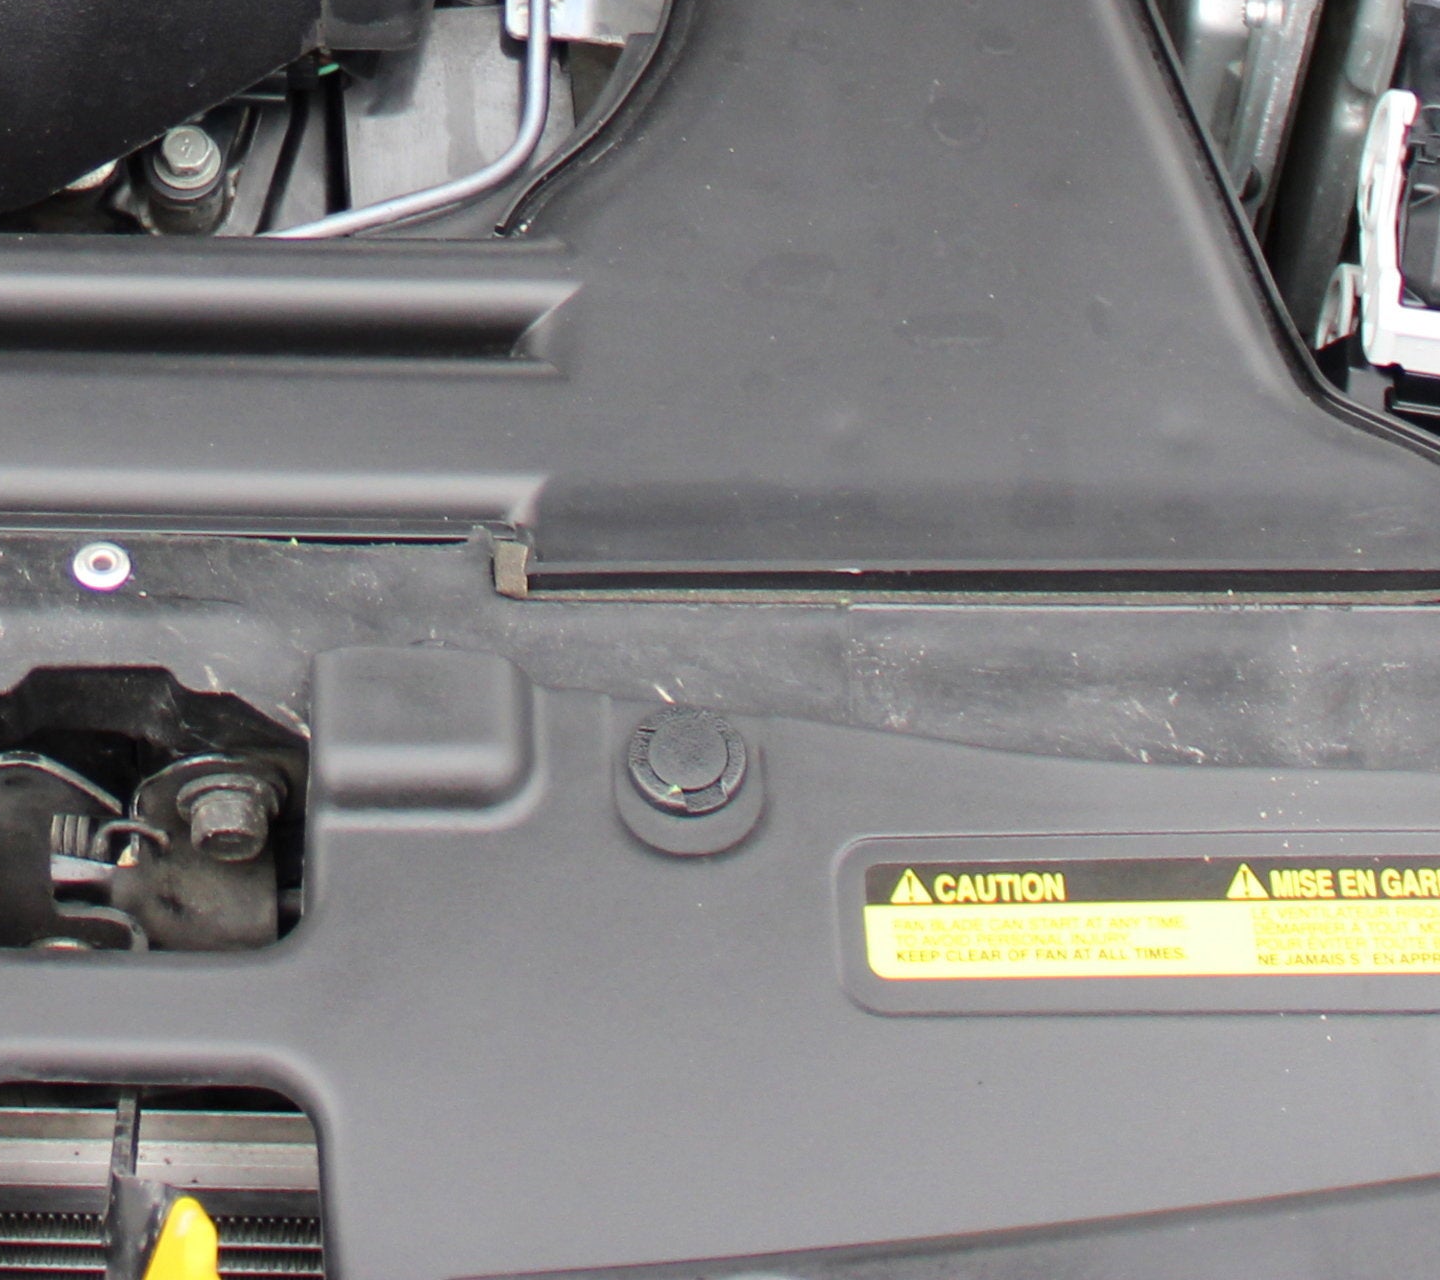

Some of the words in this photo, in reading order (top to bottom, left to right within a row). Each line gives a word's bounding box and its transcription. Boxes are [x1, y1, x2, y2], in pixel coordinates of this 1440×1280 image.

[933, 873, 1066, 903] CAUTION
[1269, 869, 1335, 899] MISE
[1338, 869, 1377, 899] EN
[896, 949, 941, 962] KEEP
[948, 949, 1001, 962] CLEAR
[1007, 949, 1030, 962] OF
[1035, 949, 1067, 962] FAN
[1073, 949, 1091, 962] AT
[1098, 949, 1128, 962] ALL
[1258, 953, 1278, 966] NE
[1285, 953, 1345, 966] JAMAIS
[1374, 953, 1396, 966] EN
